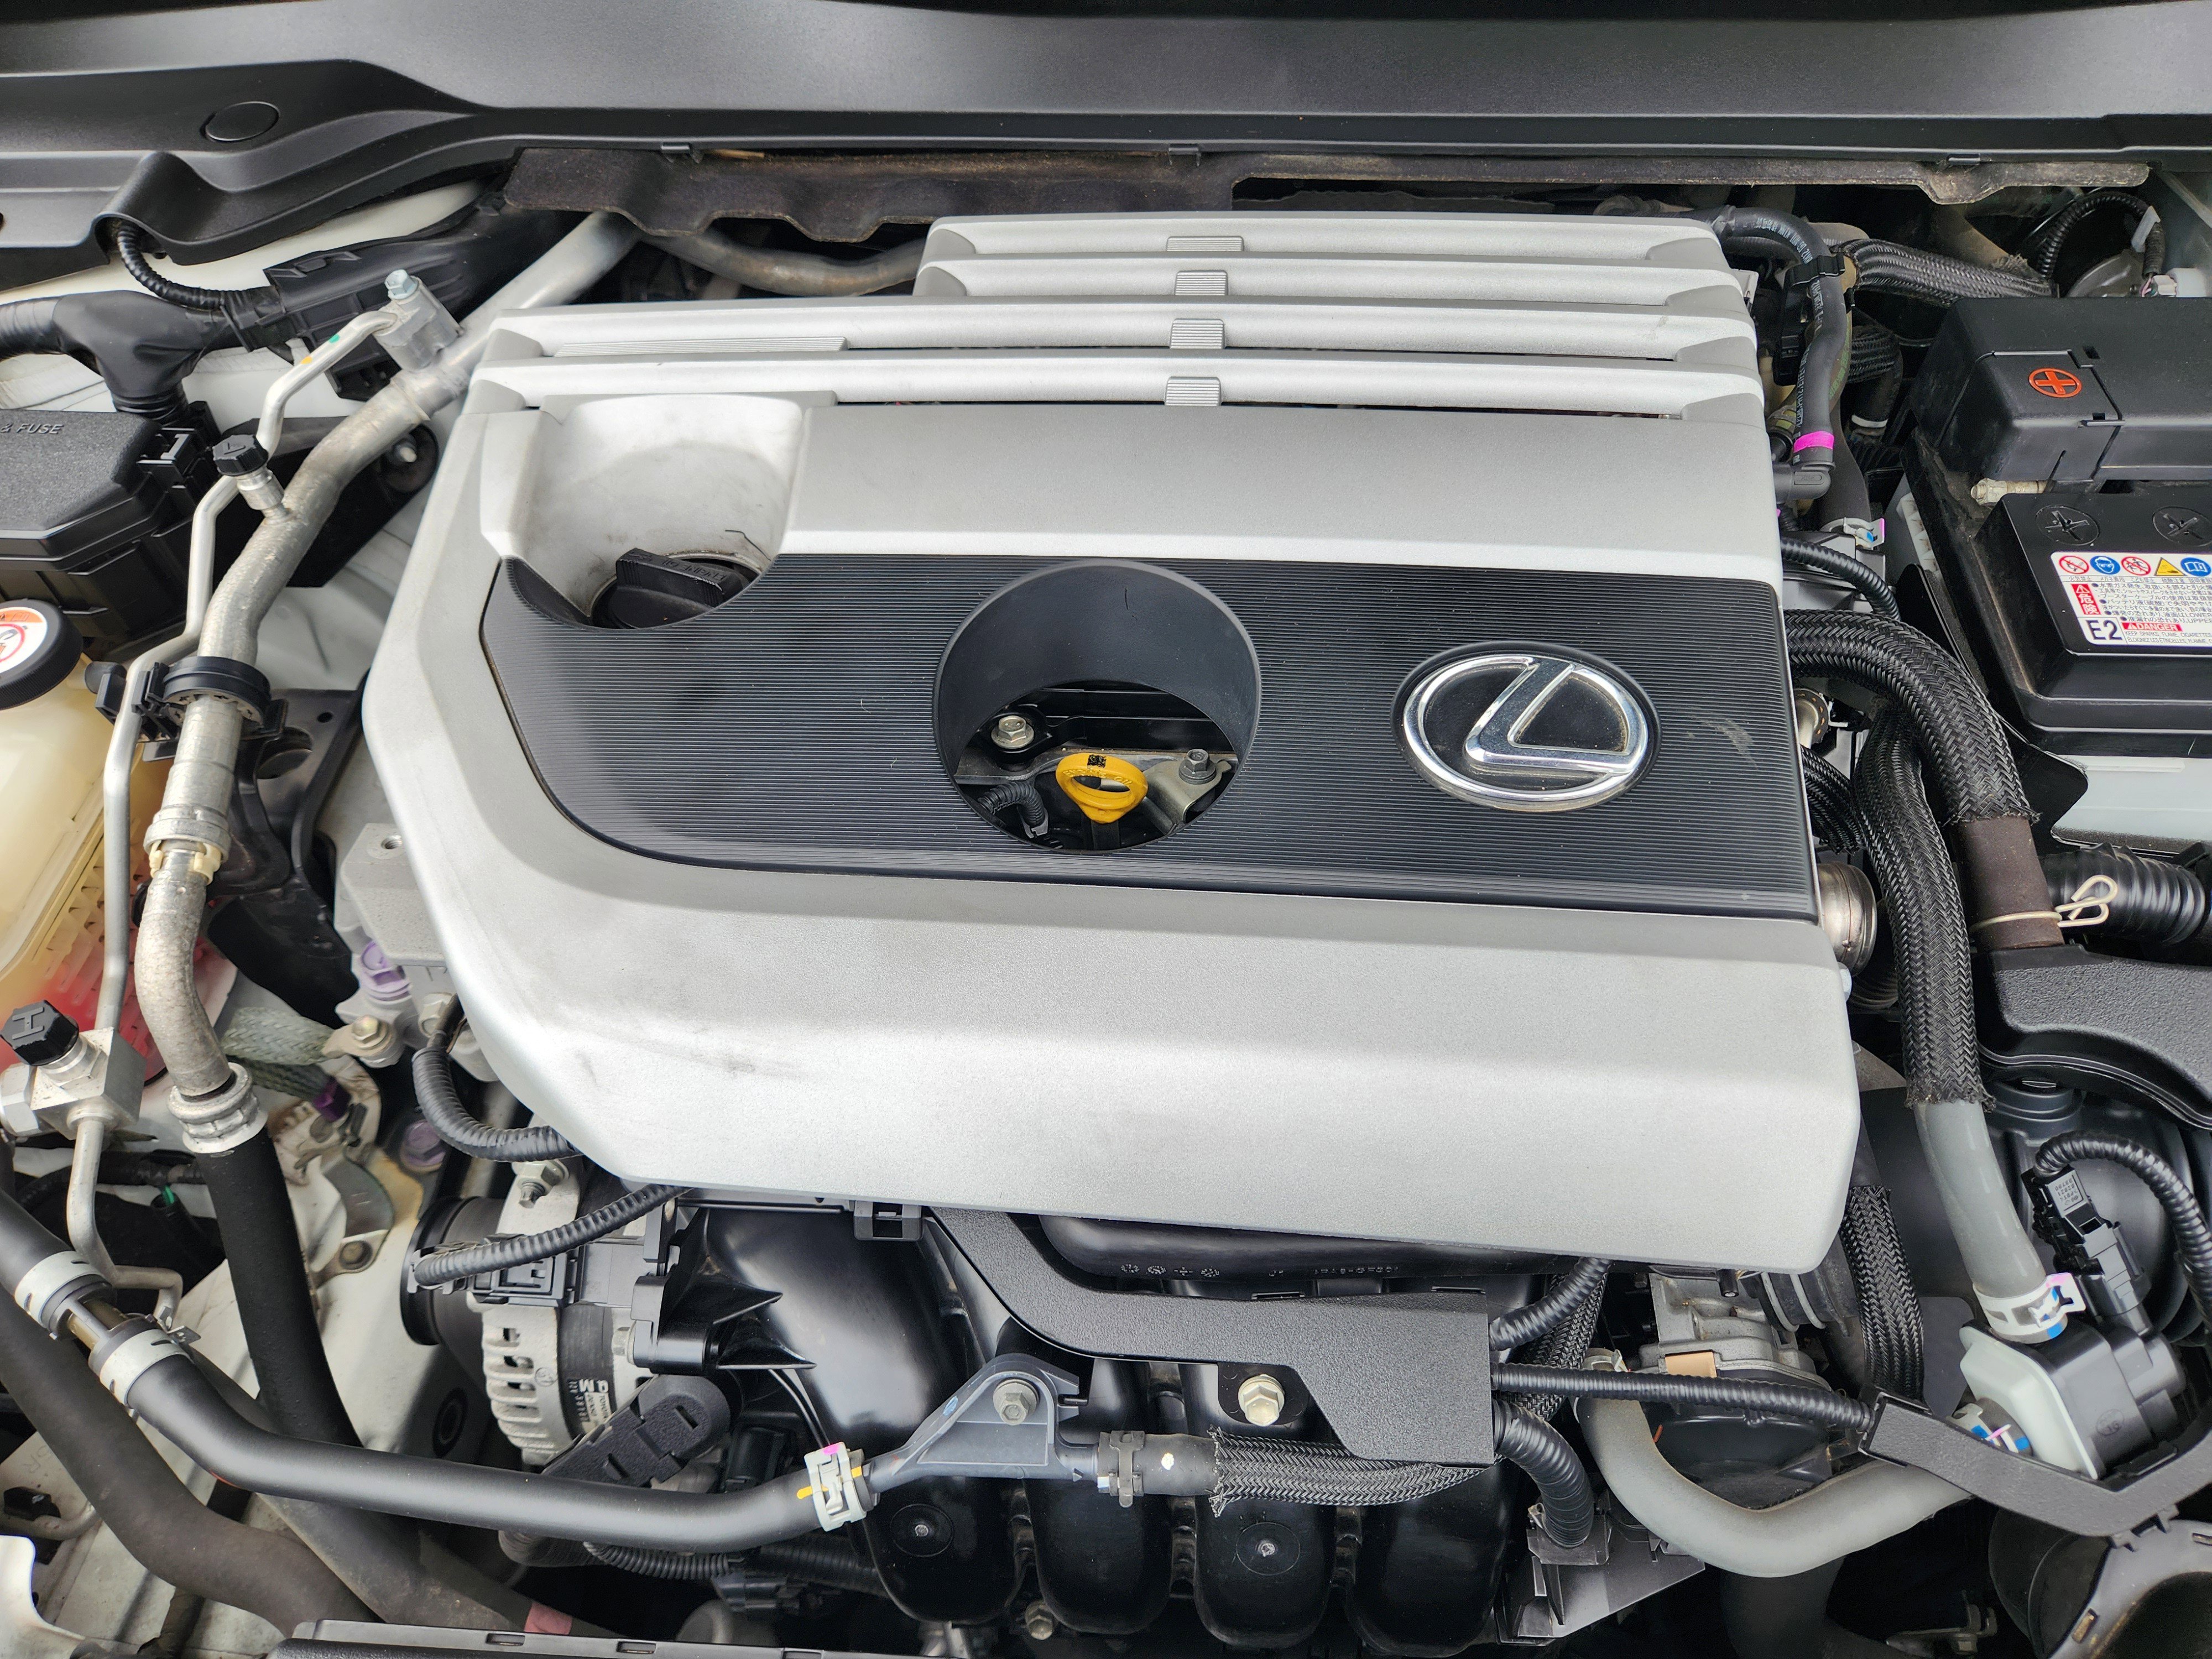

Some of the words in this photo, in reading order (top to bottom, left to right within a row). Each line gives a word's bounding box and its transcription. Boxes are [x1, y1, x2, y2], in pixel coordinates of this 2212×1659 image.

[16, 423, 65, 435] FUSE
[2078, 592, 2100, 615] 危険
[2085, 619, 2123, 640] E2
[2136, 623, 2179, 631] DANGER
[11, 1006, 45, 1040] H
